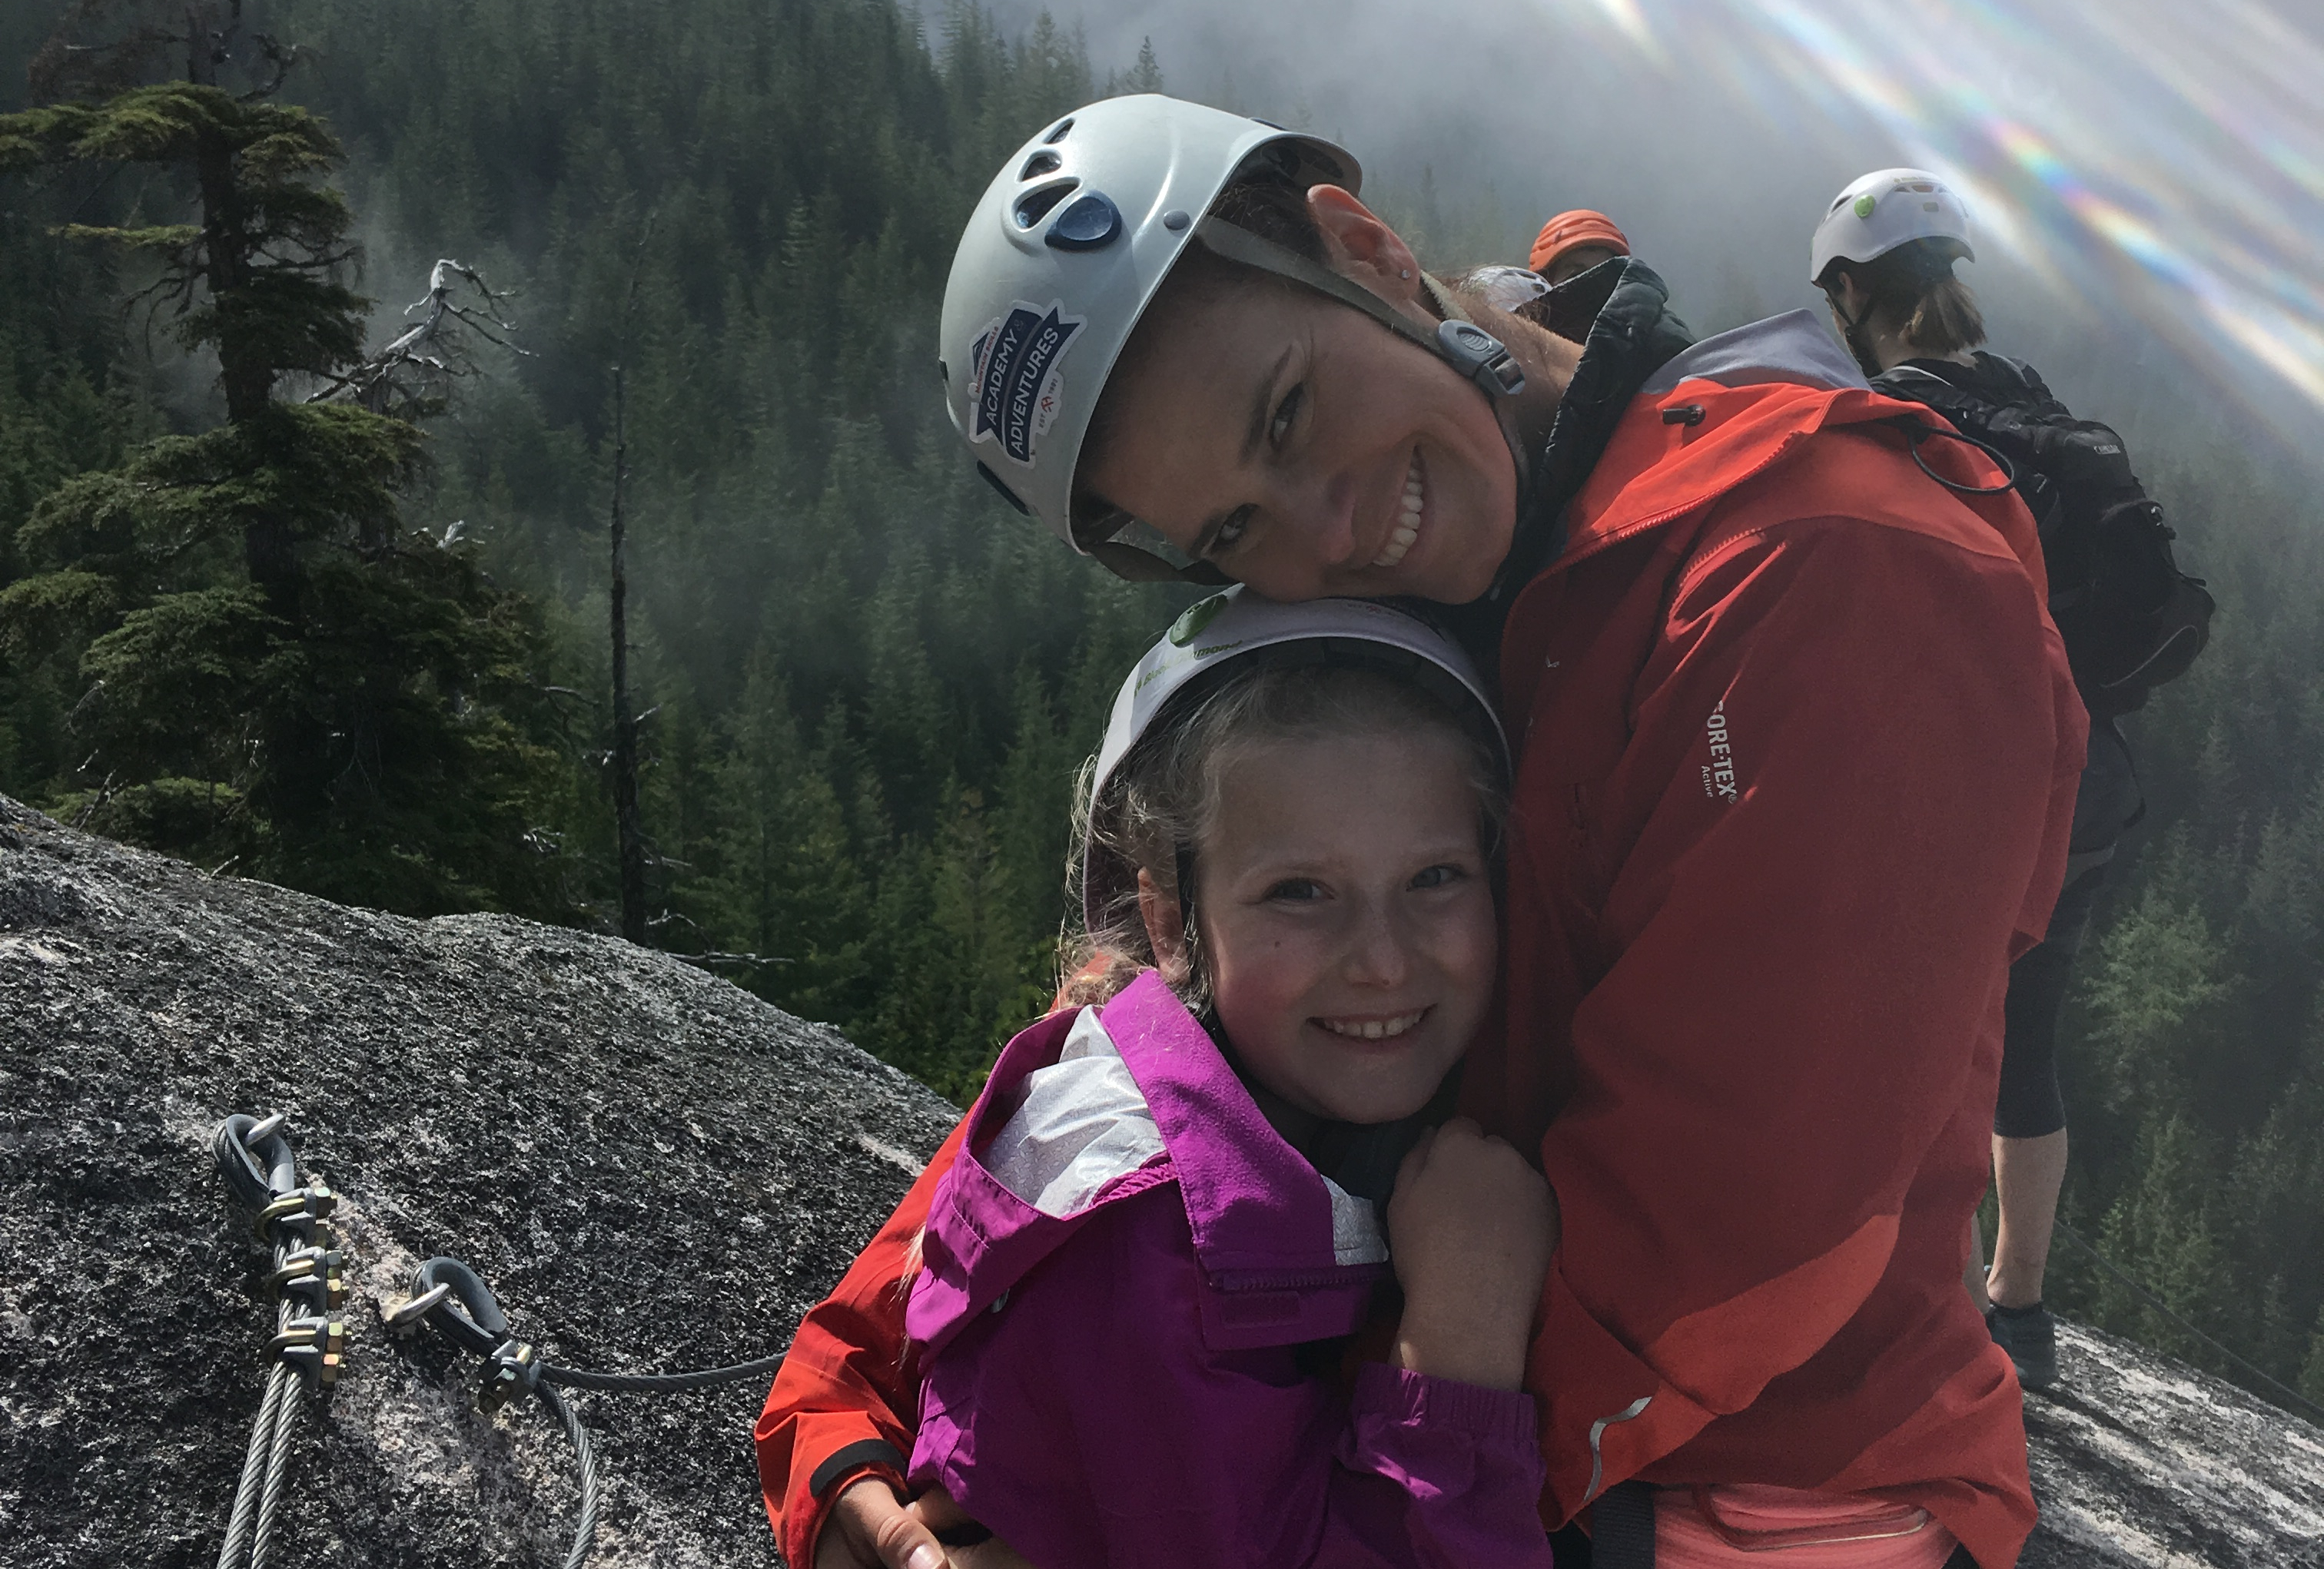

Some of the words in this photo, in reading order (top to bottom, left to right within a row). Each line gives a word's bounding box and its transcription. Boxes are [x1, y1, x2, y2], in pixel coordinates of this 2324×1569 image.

[985, 329, 1018, 426] ACADEMY
[1009, 327, 1059, 455] ADVENTURES
[1701, 765, 1714, 798] Active
